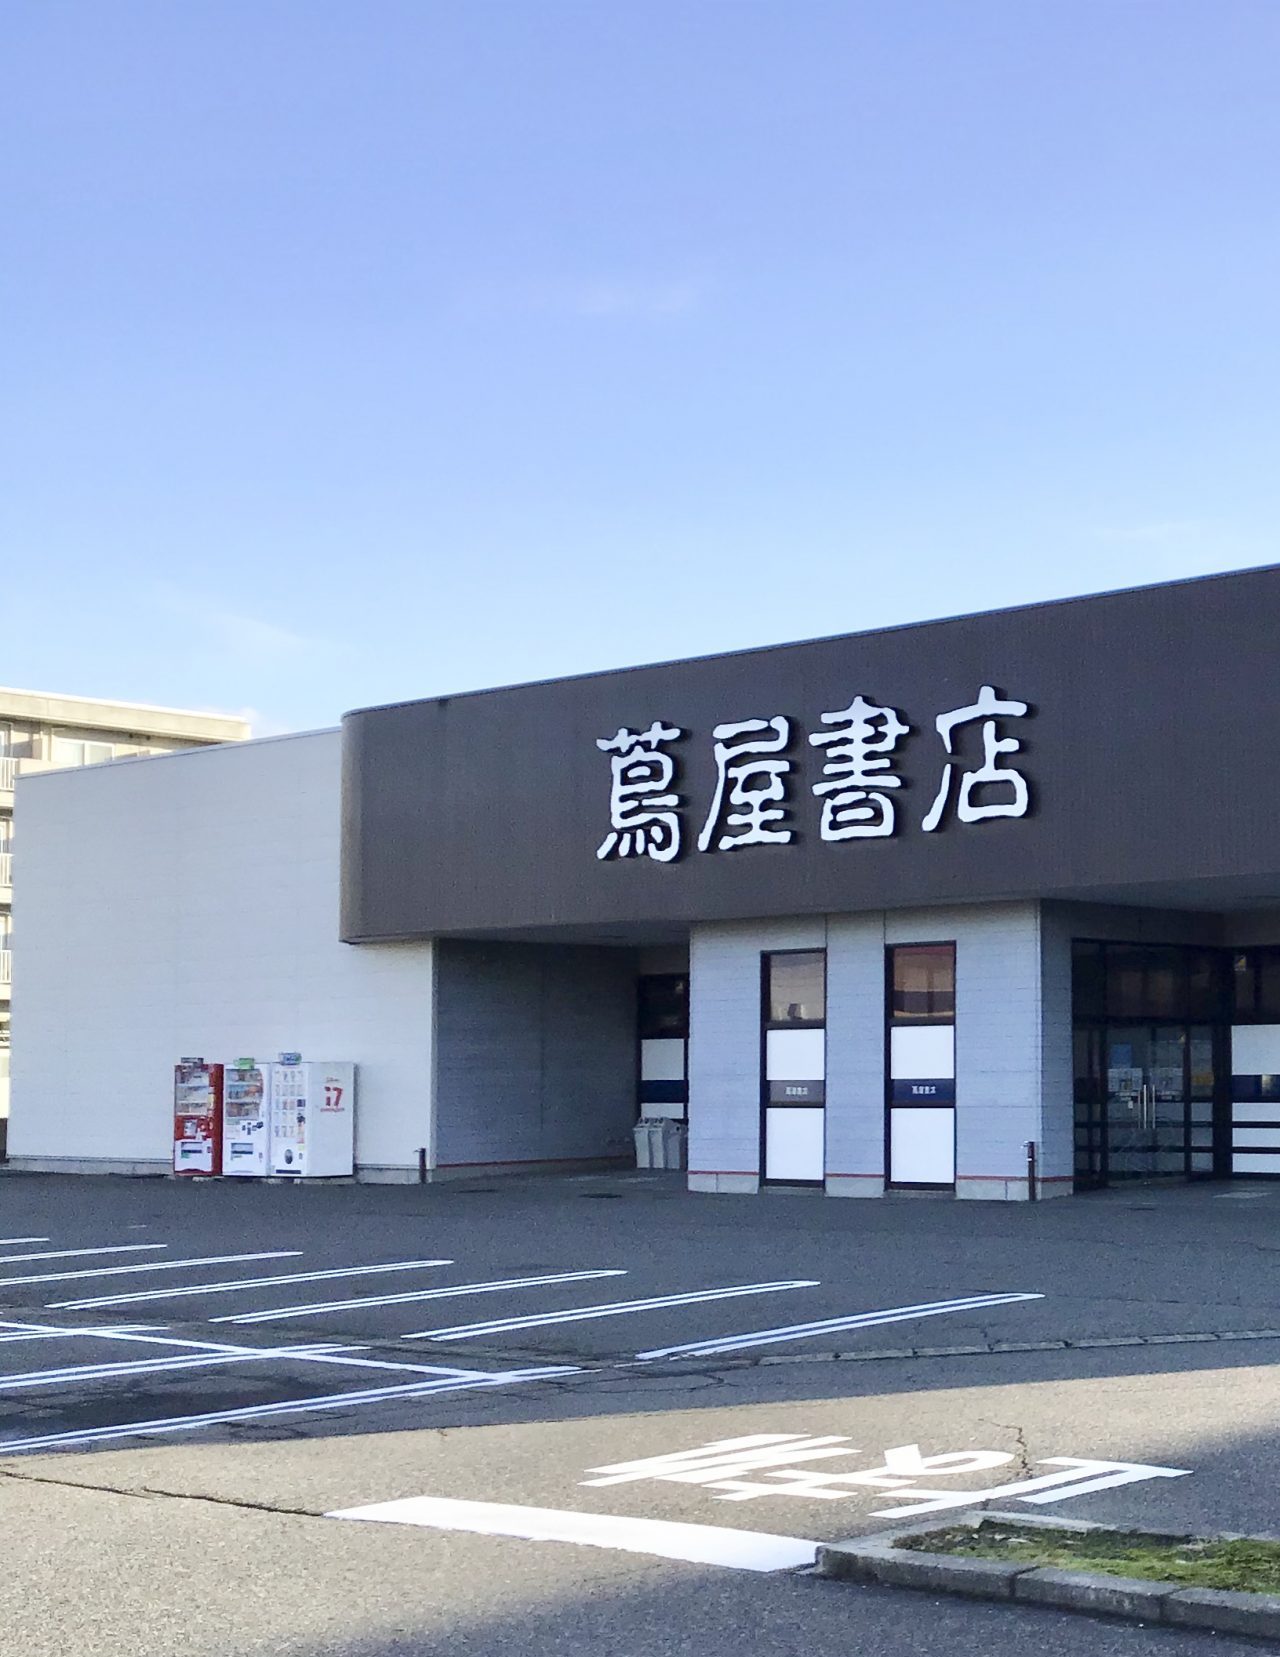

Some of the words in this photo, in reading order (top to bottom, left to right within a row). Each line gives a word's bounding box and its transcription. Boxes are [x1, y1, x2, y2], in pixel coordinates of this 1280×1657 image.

[596, 685, 1029, 862] 蔦屋書店
[578, 1433, 1192, 1519] 止まれ
